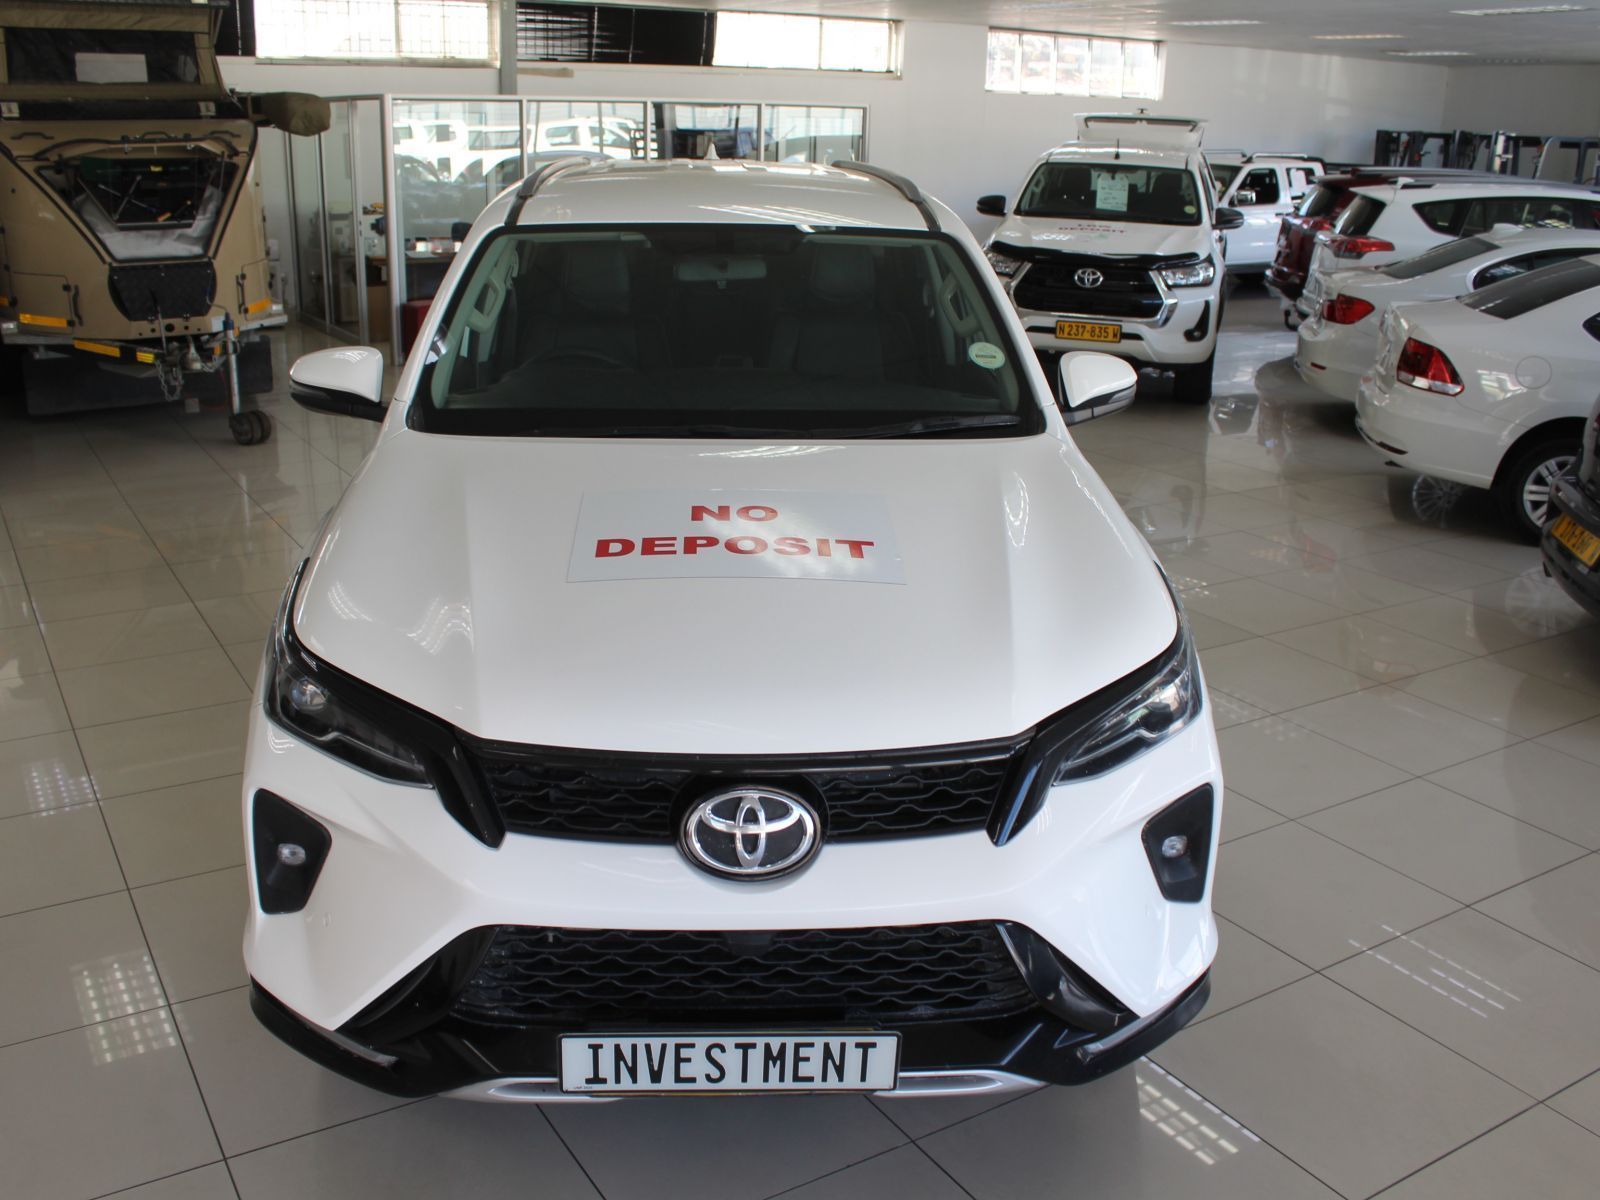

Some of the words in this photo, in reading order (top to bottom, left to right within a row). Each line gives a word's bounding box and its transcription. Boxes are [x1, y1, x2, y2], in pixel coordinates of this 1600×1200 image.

[1058, 323, 1066, 336] N
[691, 505, 778, 522] NO
[595, 536, 876, 559] DEPOSIT
[586, 1042, 877, 1085] INVESTMENT
